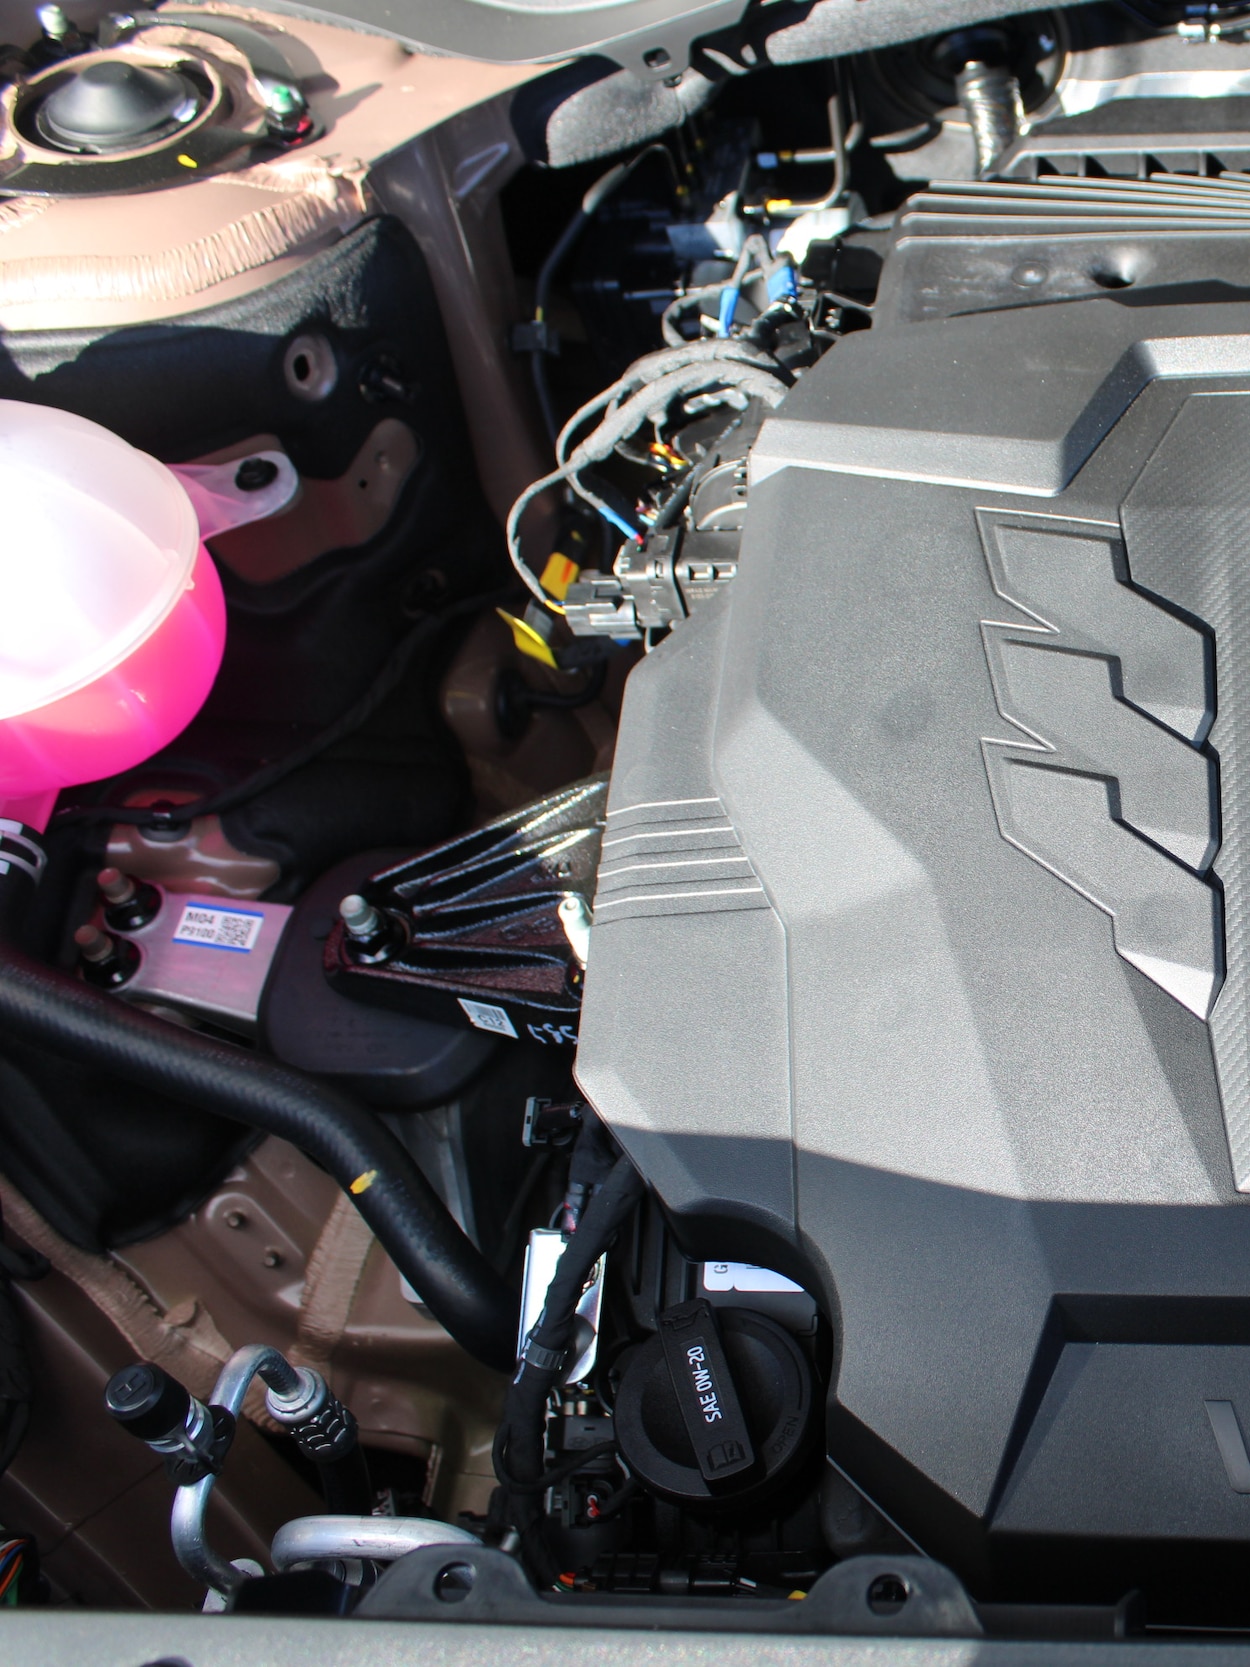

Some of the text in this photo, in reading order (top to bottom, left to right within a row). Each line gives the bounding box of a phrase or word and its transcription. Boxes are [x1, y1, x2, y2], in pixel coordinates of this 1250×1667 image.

[686, 1346, 722, 1423] SAE 0W-20
[771, 1415, 800, 1454] OPEN
